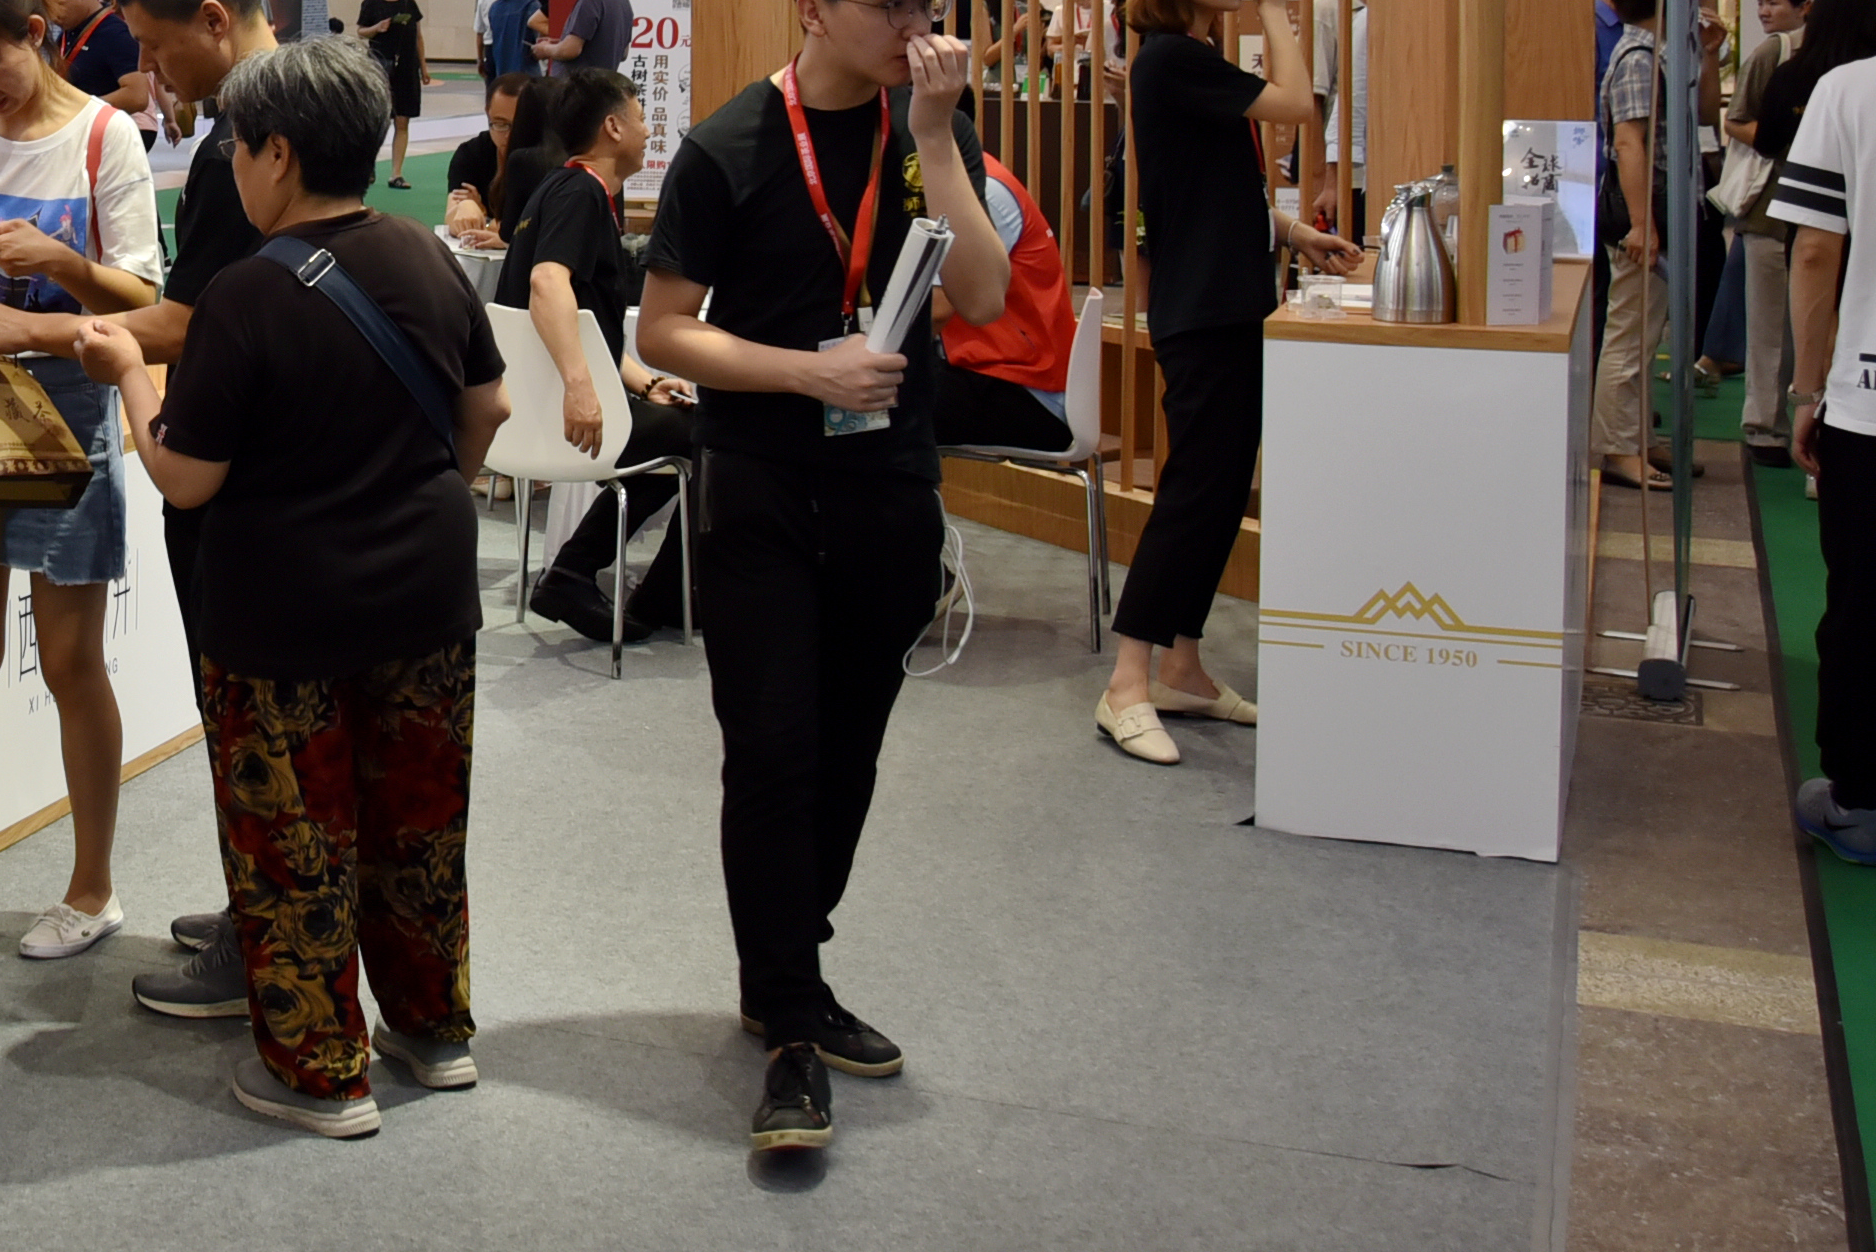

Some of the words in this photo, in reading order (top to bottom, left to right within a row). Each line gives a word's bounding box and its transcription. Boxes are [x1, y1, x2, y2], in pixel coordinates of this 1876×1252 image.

[653, 54, 669, 102] 用实价
[650, 106, 668, 155] 品真味
[1339, 638, 1419, 666] SINCE
[1425, 645, 1479, 669] 1950
